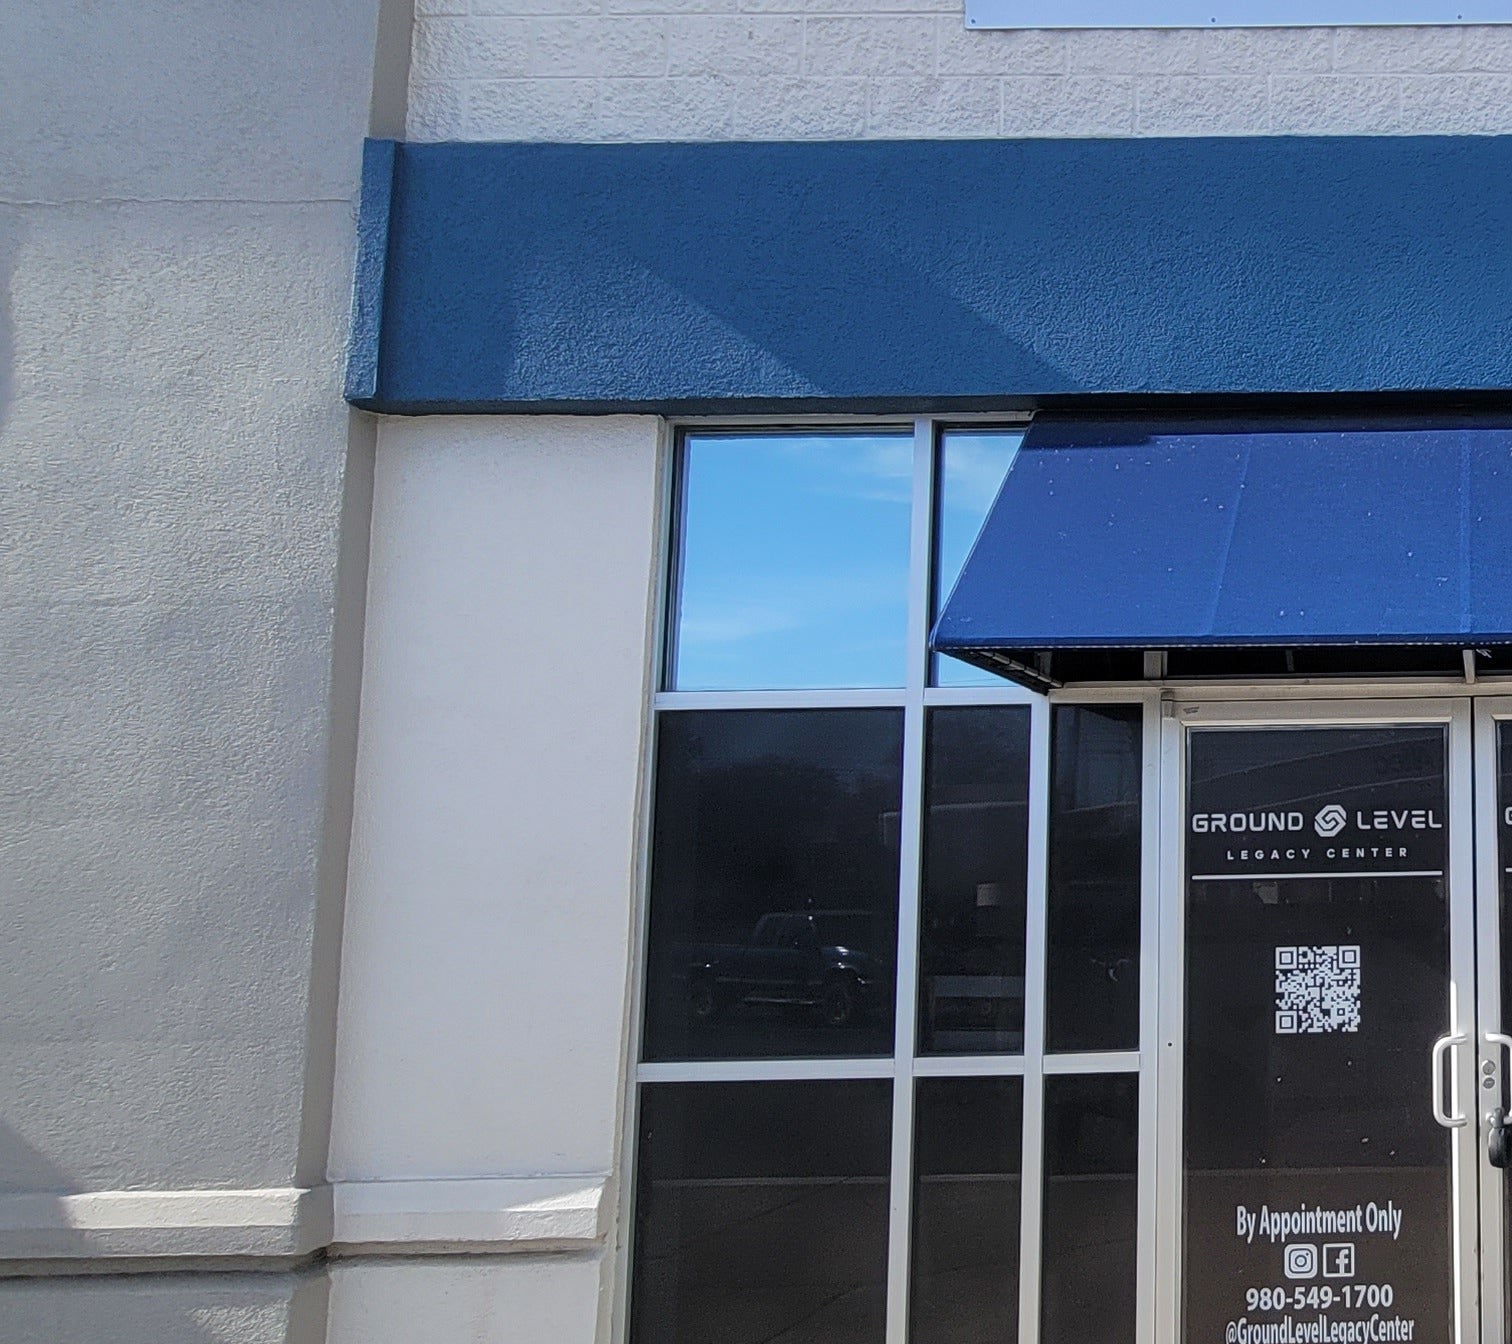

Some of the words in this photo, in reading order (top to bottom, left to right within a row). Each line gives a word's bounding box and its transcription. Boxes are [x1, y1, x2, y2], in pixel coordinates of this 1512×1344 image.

[1192, 812, 1304, 833] GROUND
[1356, 809, 1442, 830] LEVEL
[1226, 848, 1311, 861] LEGACY
[1326, 847, 1408, 859] CENTER
[1236, 1205, 1257, 1244] By
[1258, 1202, 1363, 1242] Appointment
[1365, 1200, 1402, 1238] Only
[1245, 1283, 1394, 1312] 980-549-1700
